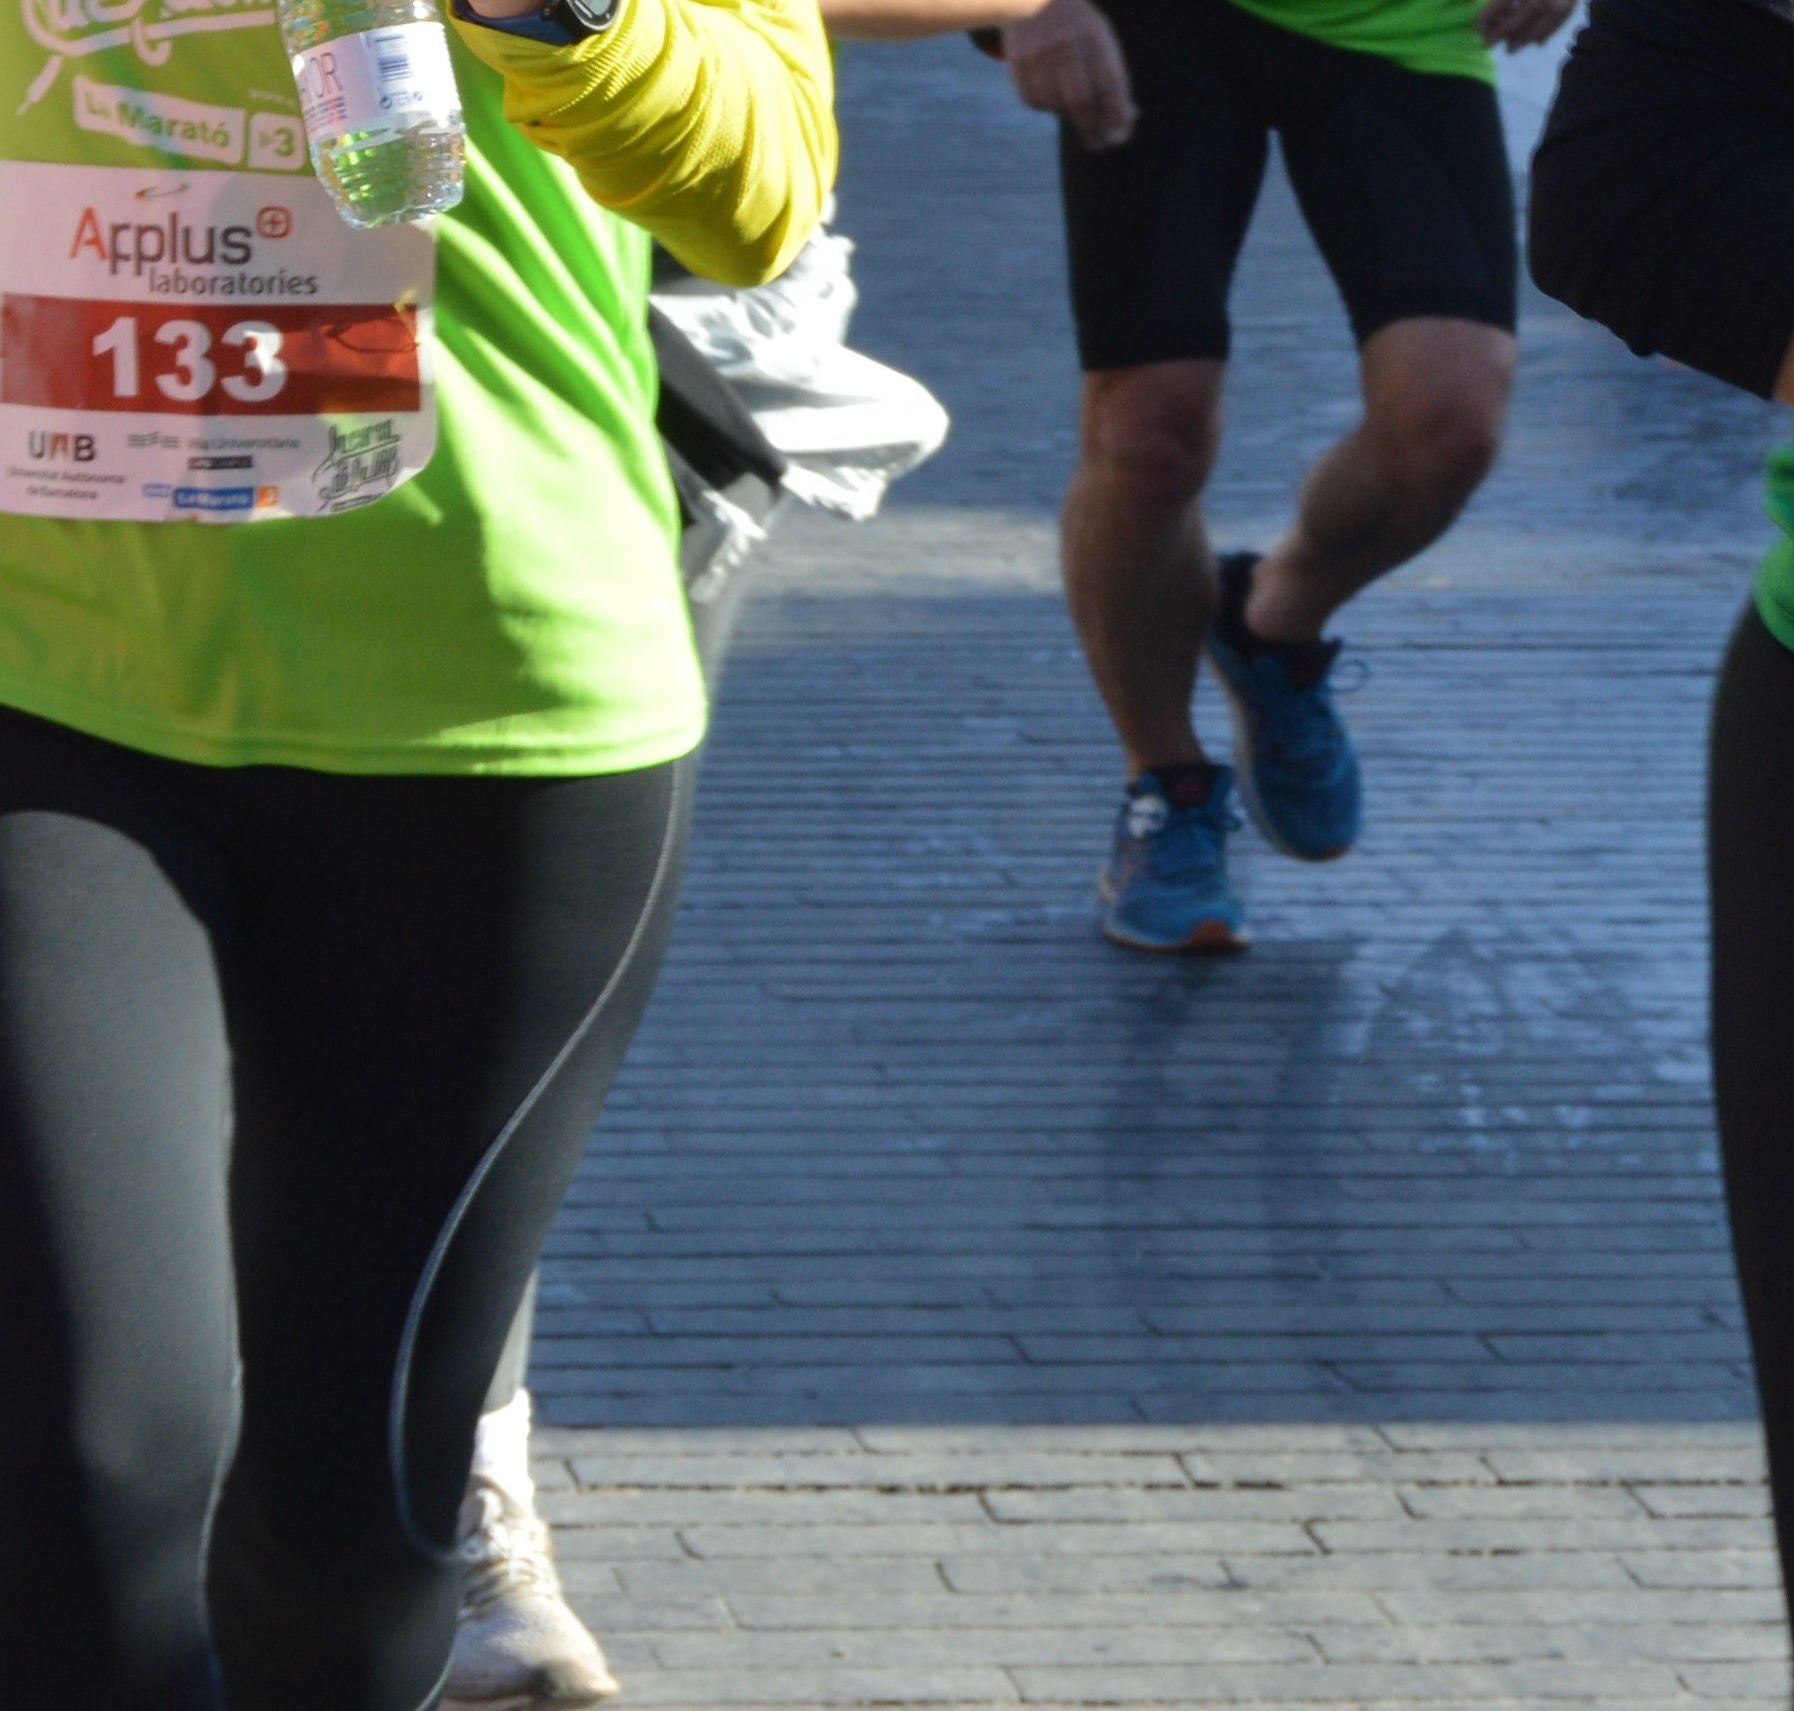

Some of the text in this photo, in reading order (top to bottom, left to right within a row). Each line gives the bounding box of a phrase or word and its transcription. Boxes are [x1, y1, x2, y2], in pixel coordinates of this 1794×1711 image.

[116, 101, 231, 148] Marató
[148, 270, 319, 296] laboratories
[92, 315, 287, 402] 133
[27, 429, 96, 463] UAB
